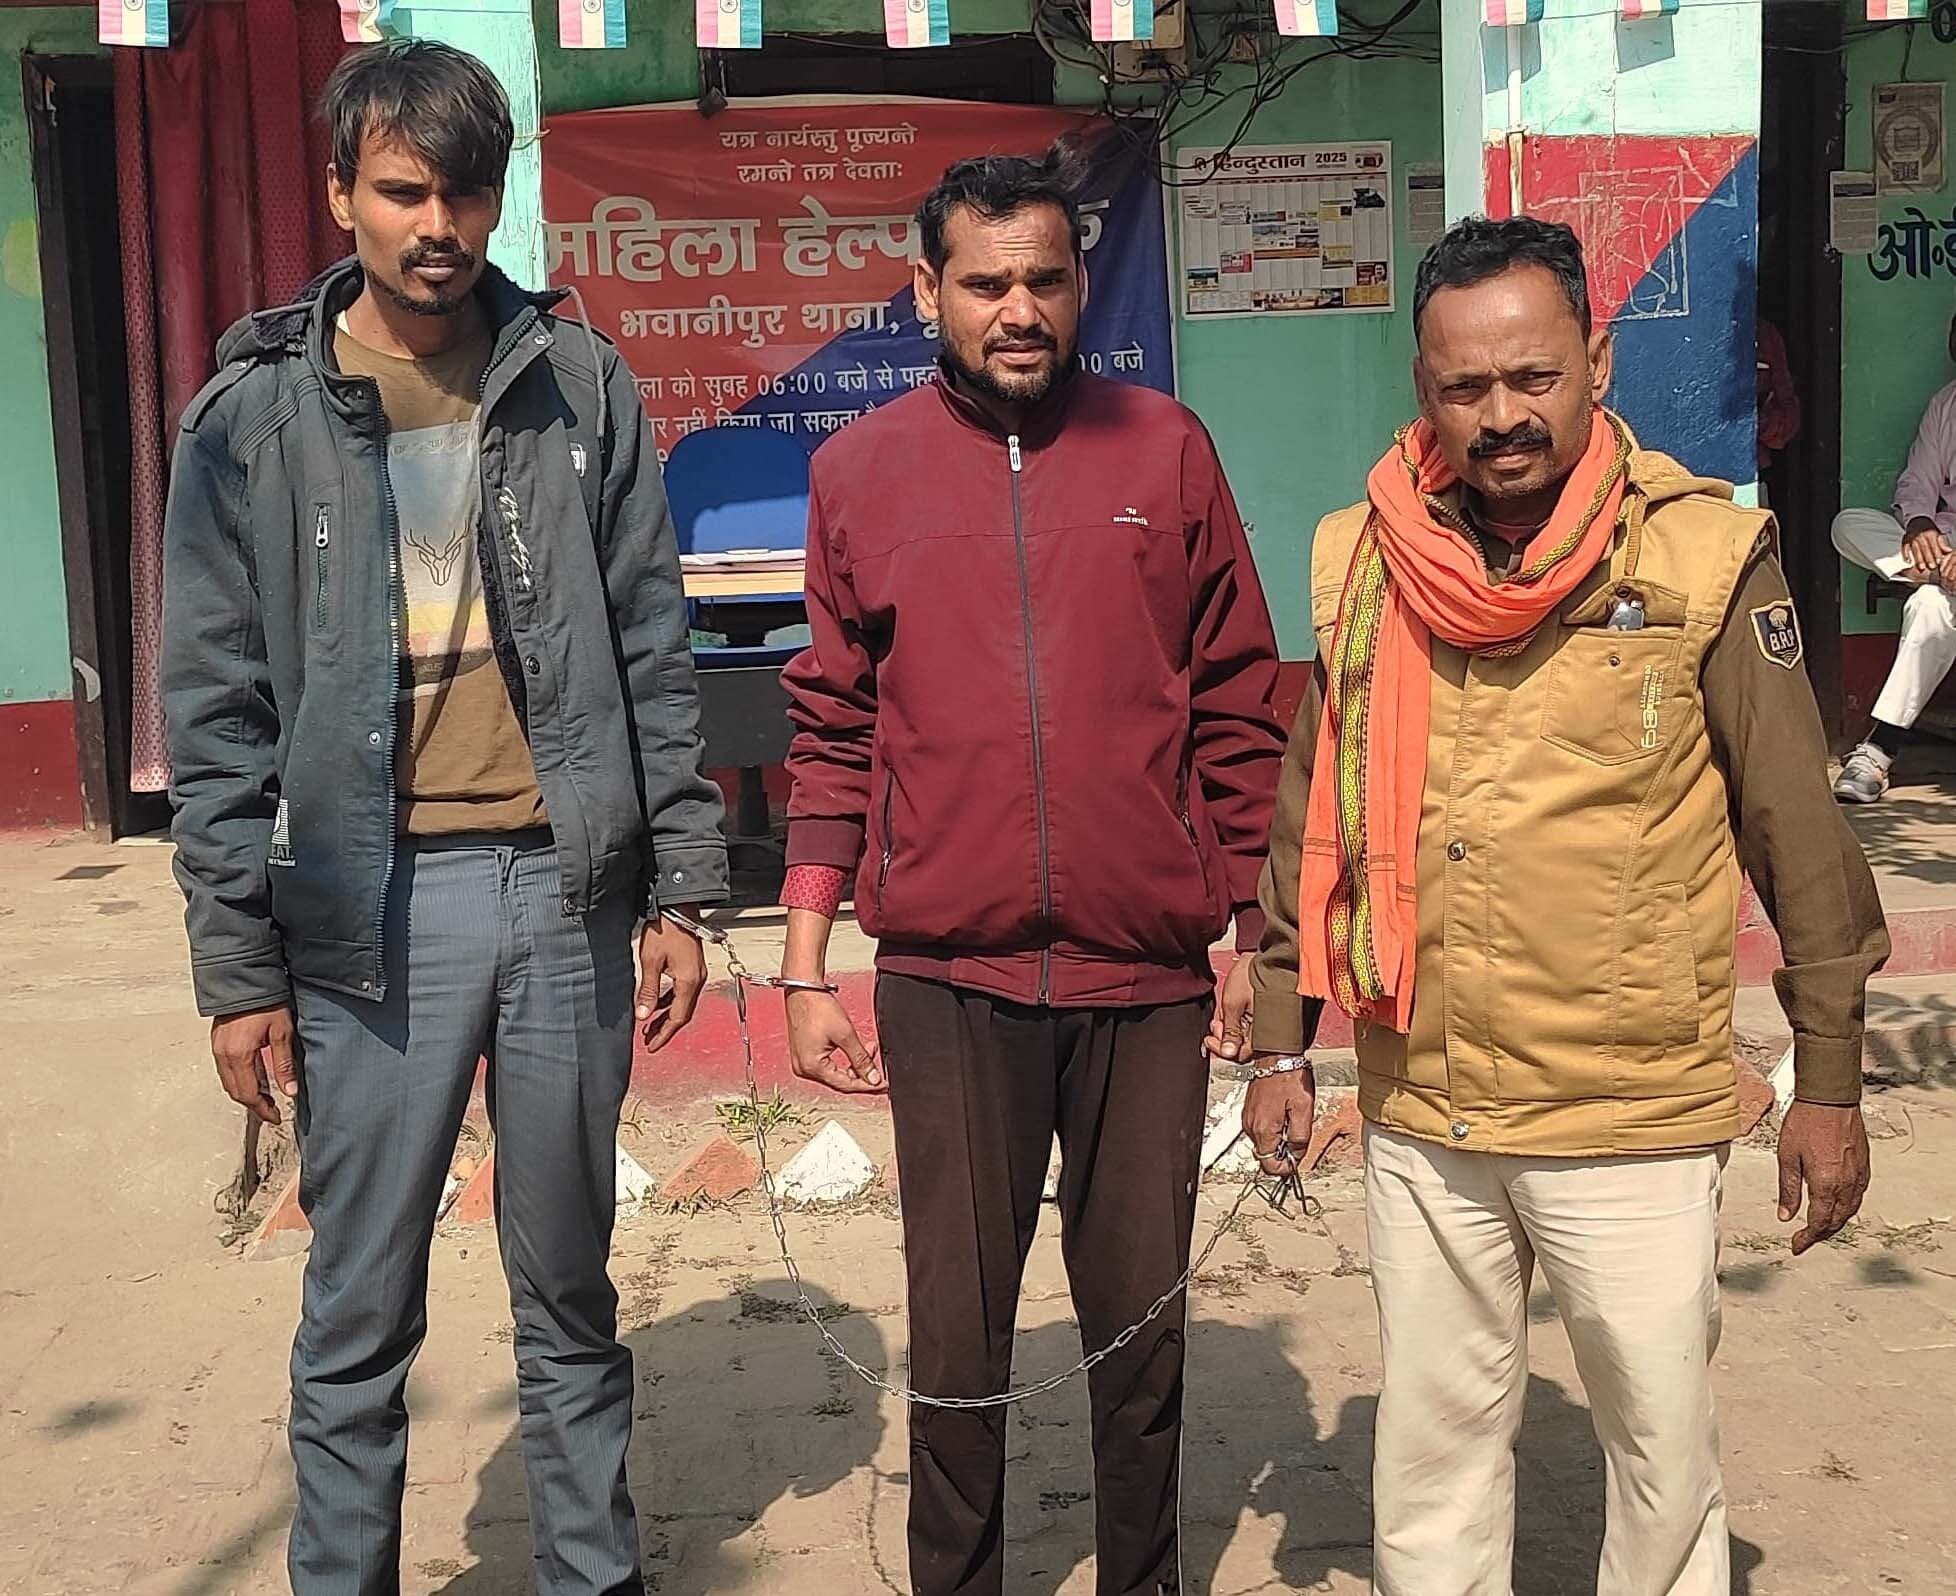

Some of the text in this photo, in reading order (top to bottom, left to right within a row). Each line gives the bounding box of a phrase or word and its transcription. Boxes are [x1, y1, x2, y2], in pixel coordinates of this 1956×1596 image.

[720, 122, 918, 153] यत्र नार्यस्तु पूज्यन्ते
[1315, 152, 1347, 164] 2025
[737, 159, 795, 183] रमन्ते
[802, 163, 838, 182] तत्र
[545, 196, 761, 282] महिला
[619, 295, 788, 348] भवानीपुर
[801, 301, 900, 335] थाना,
[669, 369, 696, 398] को
[703, 375, 749, 405] सुबह
[757, 372, 826, 395] 06:00
[834, 362, 869, 392] बजे
[875, 360, 894, 389] से
[1111, 341, 1144, 372] बजे
